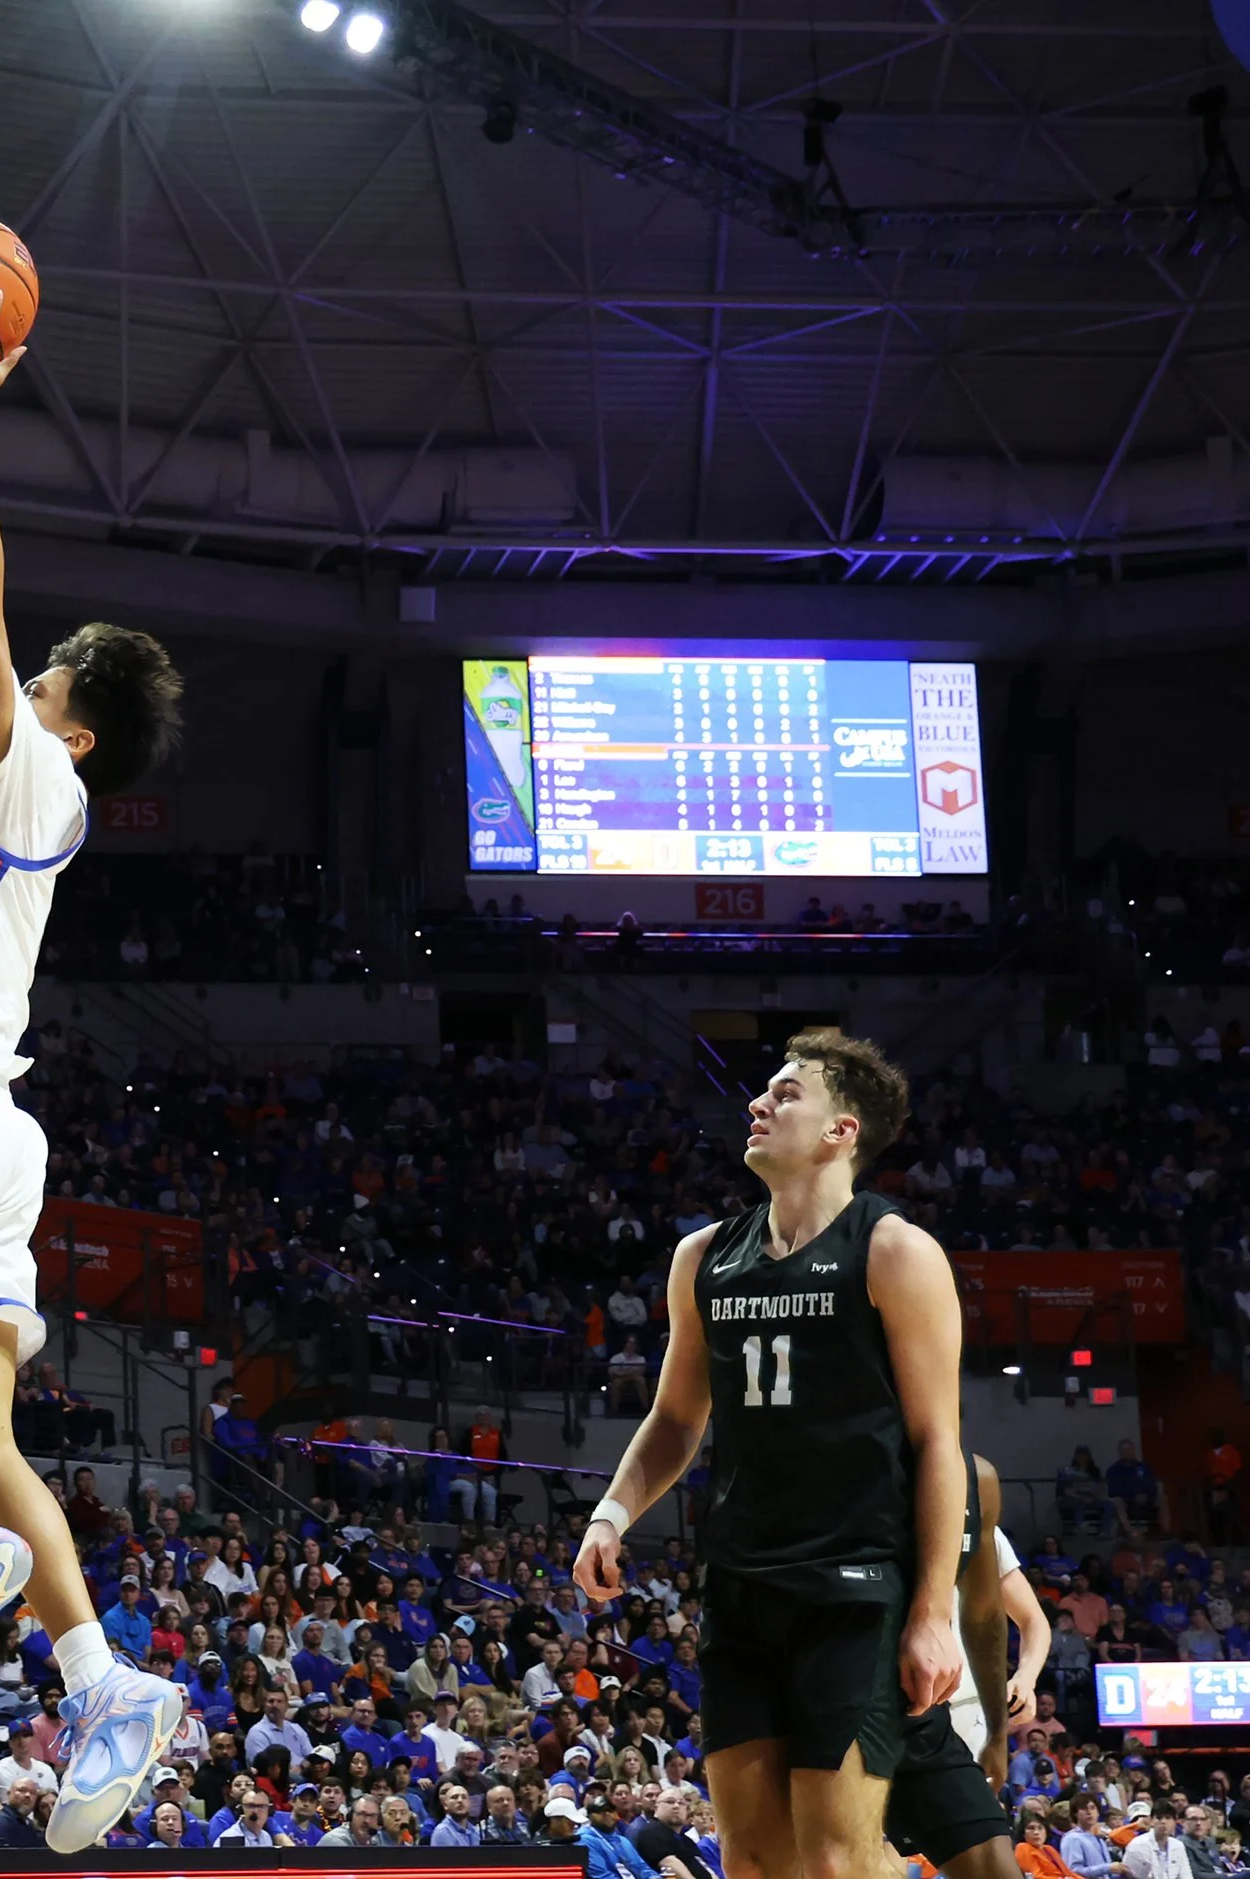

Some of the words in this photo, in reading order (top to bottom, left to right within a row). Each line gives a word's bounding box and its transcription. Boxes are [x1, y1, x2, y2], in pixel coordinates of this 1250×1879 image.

[914, 688, 974, 708] THE
[918, 725, 976, 742] BLUE
[110, 802, 158, 827] 215
[474, 830, 497, 845] GO
[706, 838, 752, 858] 2:13
[475, 846, 533, 863] GATORS
[925, 841, 982, 863] LAW
[703, 888, 757, 914] 216
[711, 1292, 835, 1322] DARTMOUTH
[1132, 1302, 1147, 1315] 17
[742, 1334, 792, 1406] 11
[1103, 1675, 1136, 1715] D
[1145, 1677, 1188, 1707] 24
